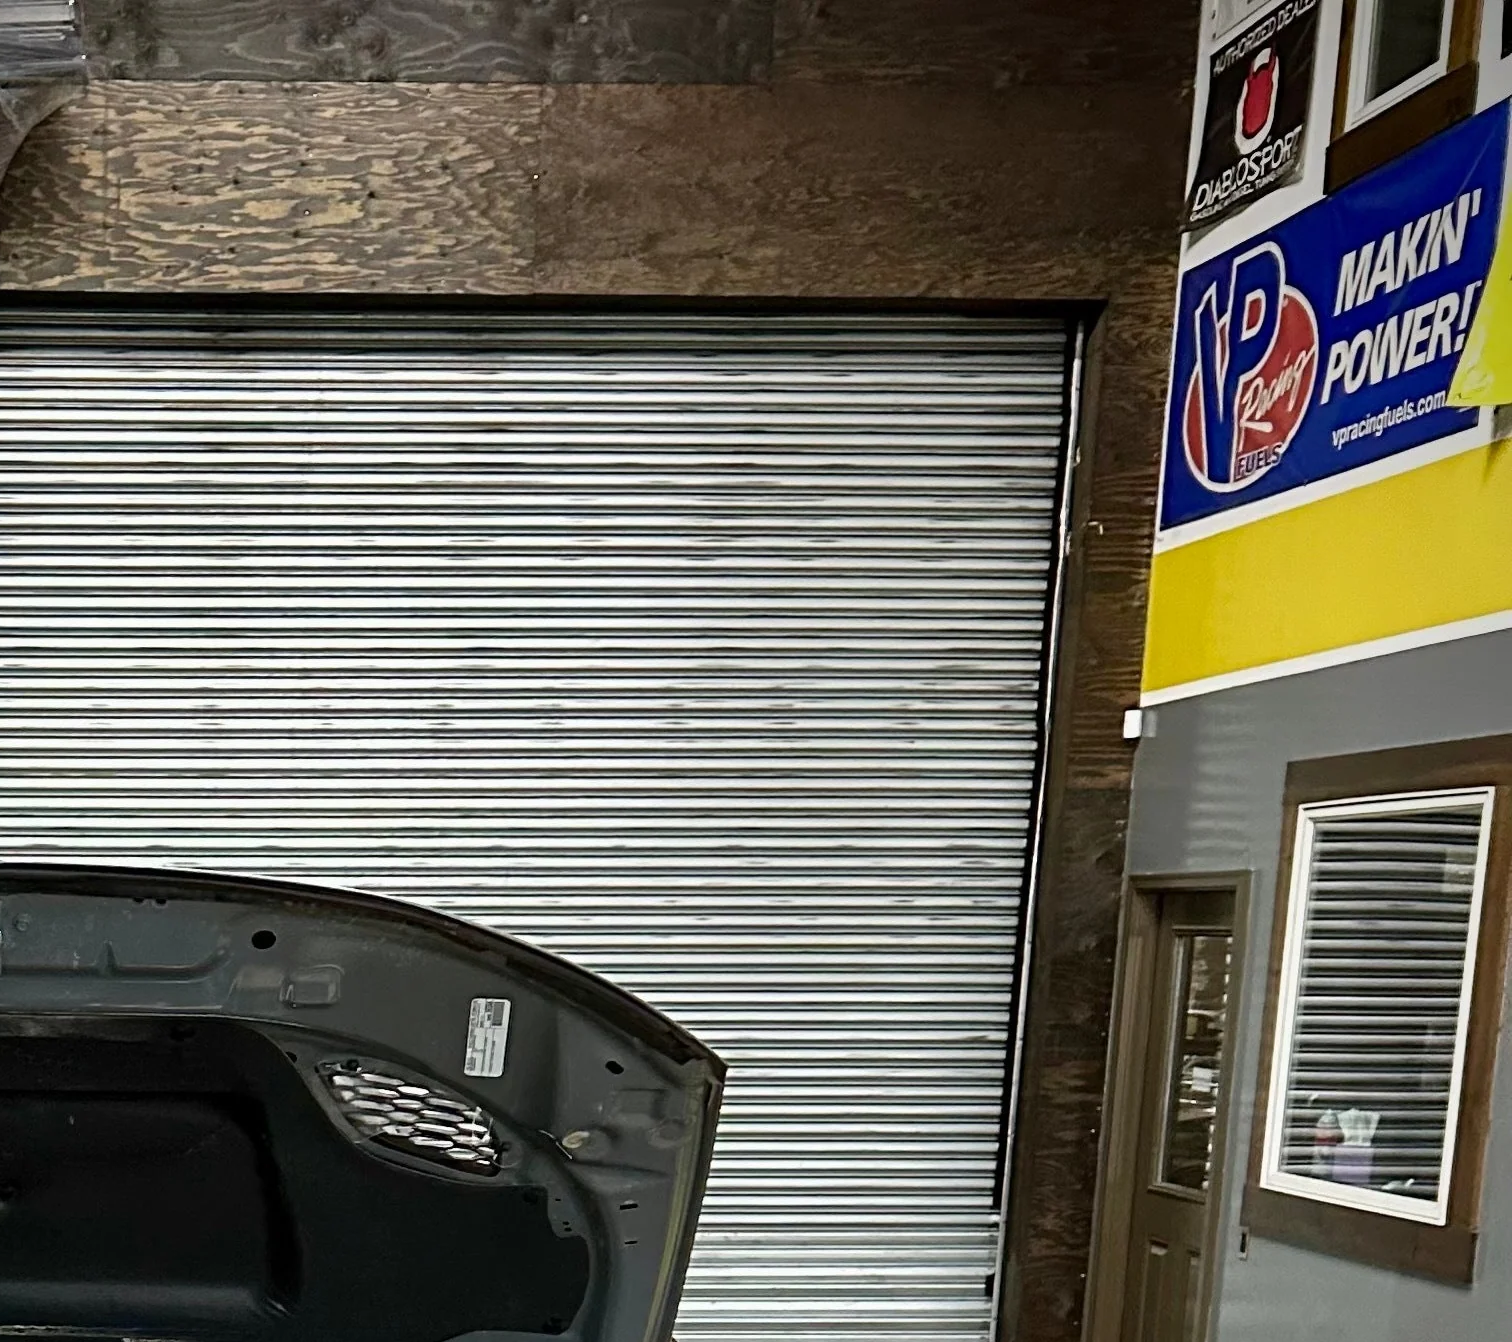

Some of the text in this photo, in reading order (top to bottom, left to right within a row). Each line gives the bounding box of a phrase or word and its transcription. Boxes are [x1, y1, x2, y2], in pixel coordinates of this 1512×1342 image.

[1213, 15, 1276, 77] AUTHORIZED
[1192, 125, 1303, 212] DIABLOSPORT
[1333, 188, 1482, 317] MAKIN'
[1194, 241, 1287, 485] VP
[1320, 280, 1483, 405] POWER!
[1240, 347, 1316, 450] Racing
[1332, 390, 1447, 450] vpracingfuels.com
[1236, 442, 1284, 479] FUELS
